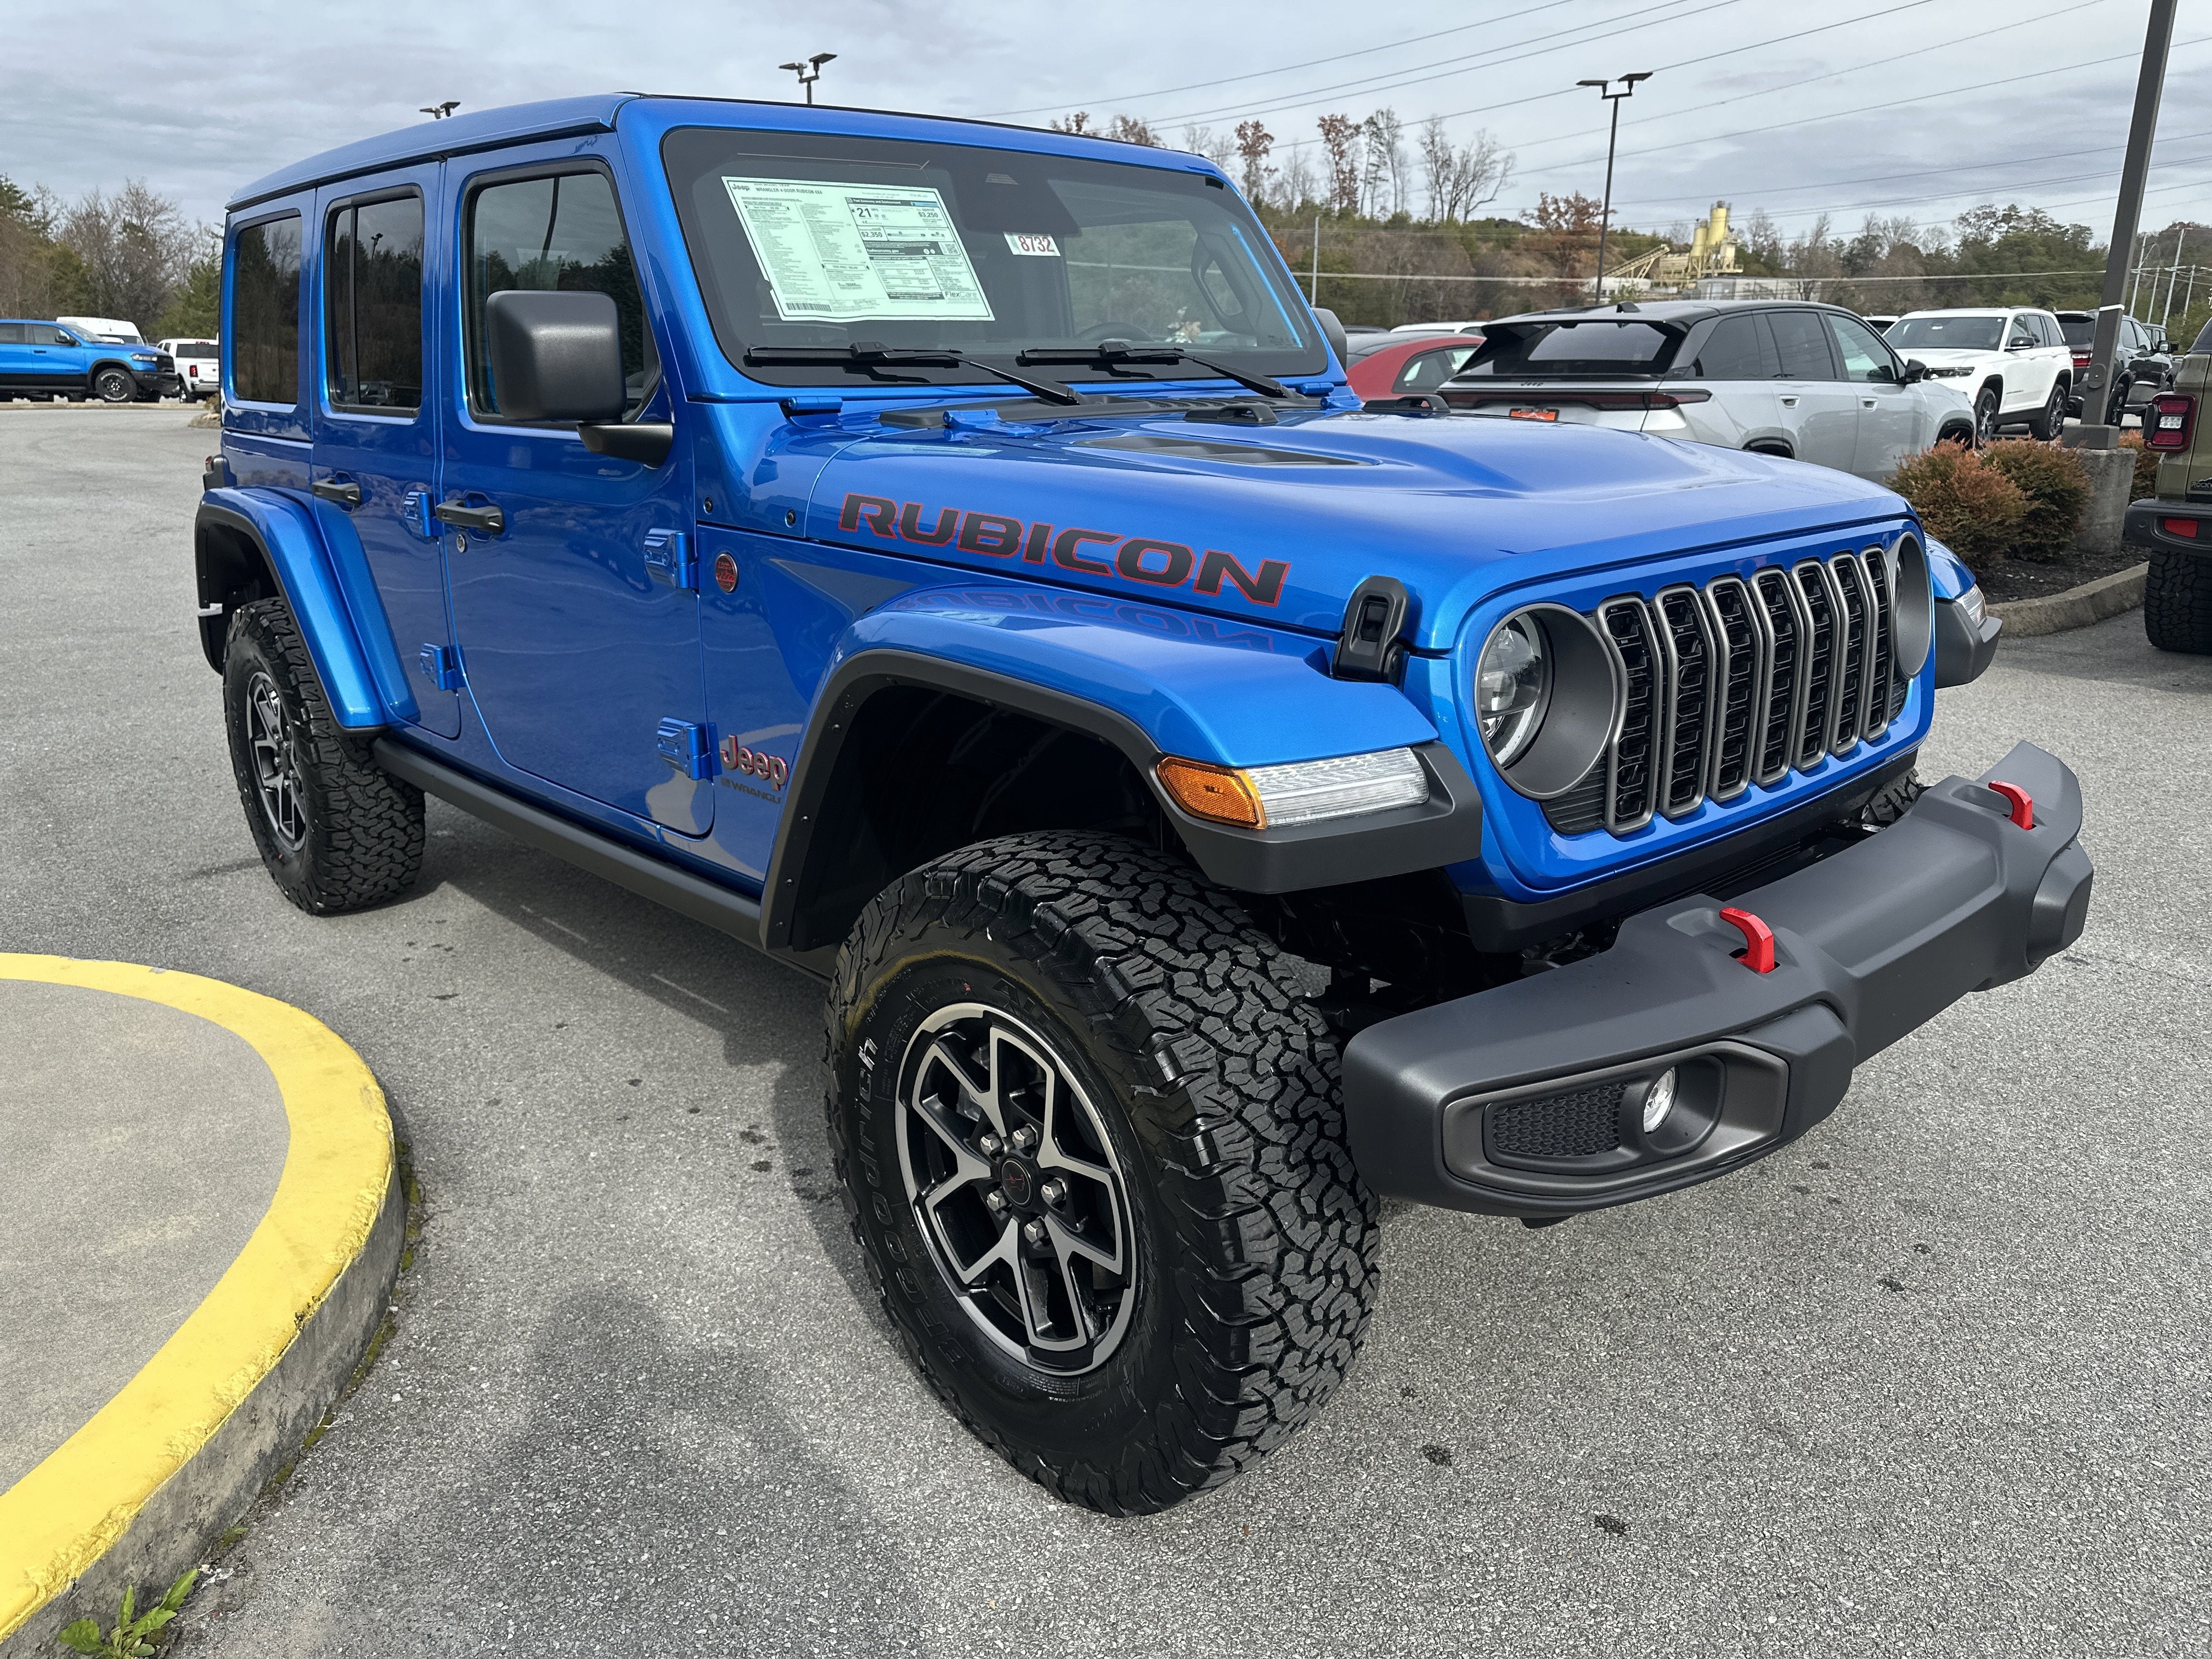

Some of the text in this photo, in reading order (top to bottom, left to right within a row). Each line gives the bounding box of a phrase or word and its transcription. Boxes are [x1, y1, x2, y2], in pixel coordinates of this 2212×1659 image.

[856, 207, 871, 217] 21
[1018, 235, 1056, 252] 8732
[838, 492, 1292, 607] RUBICON
[720, 734, 788, 791] Jeep
[854, 1036, 974, 1371] BFGoodrich
